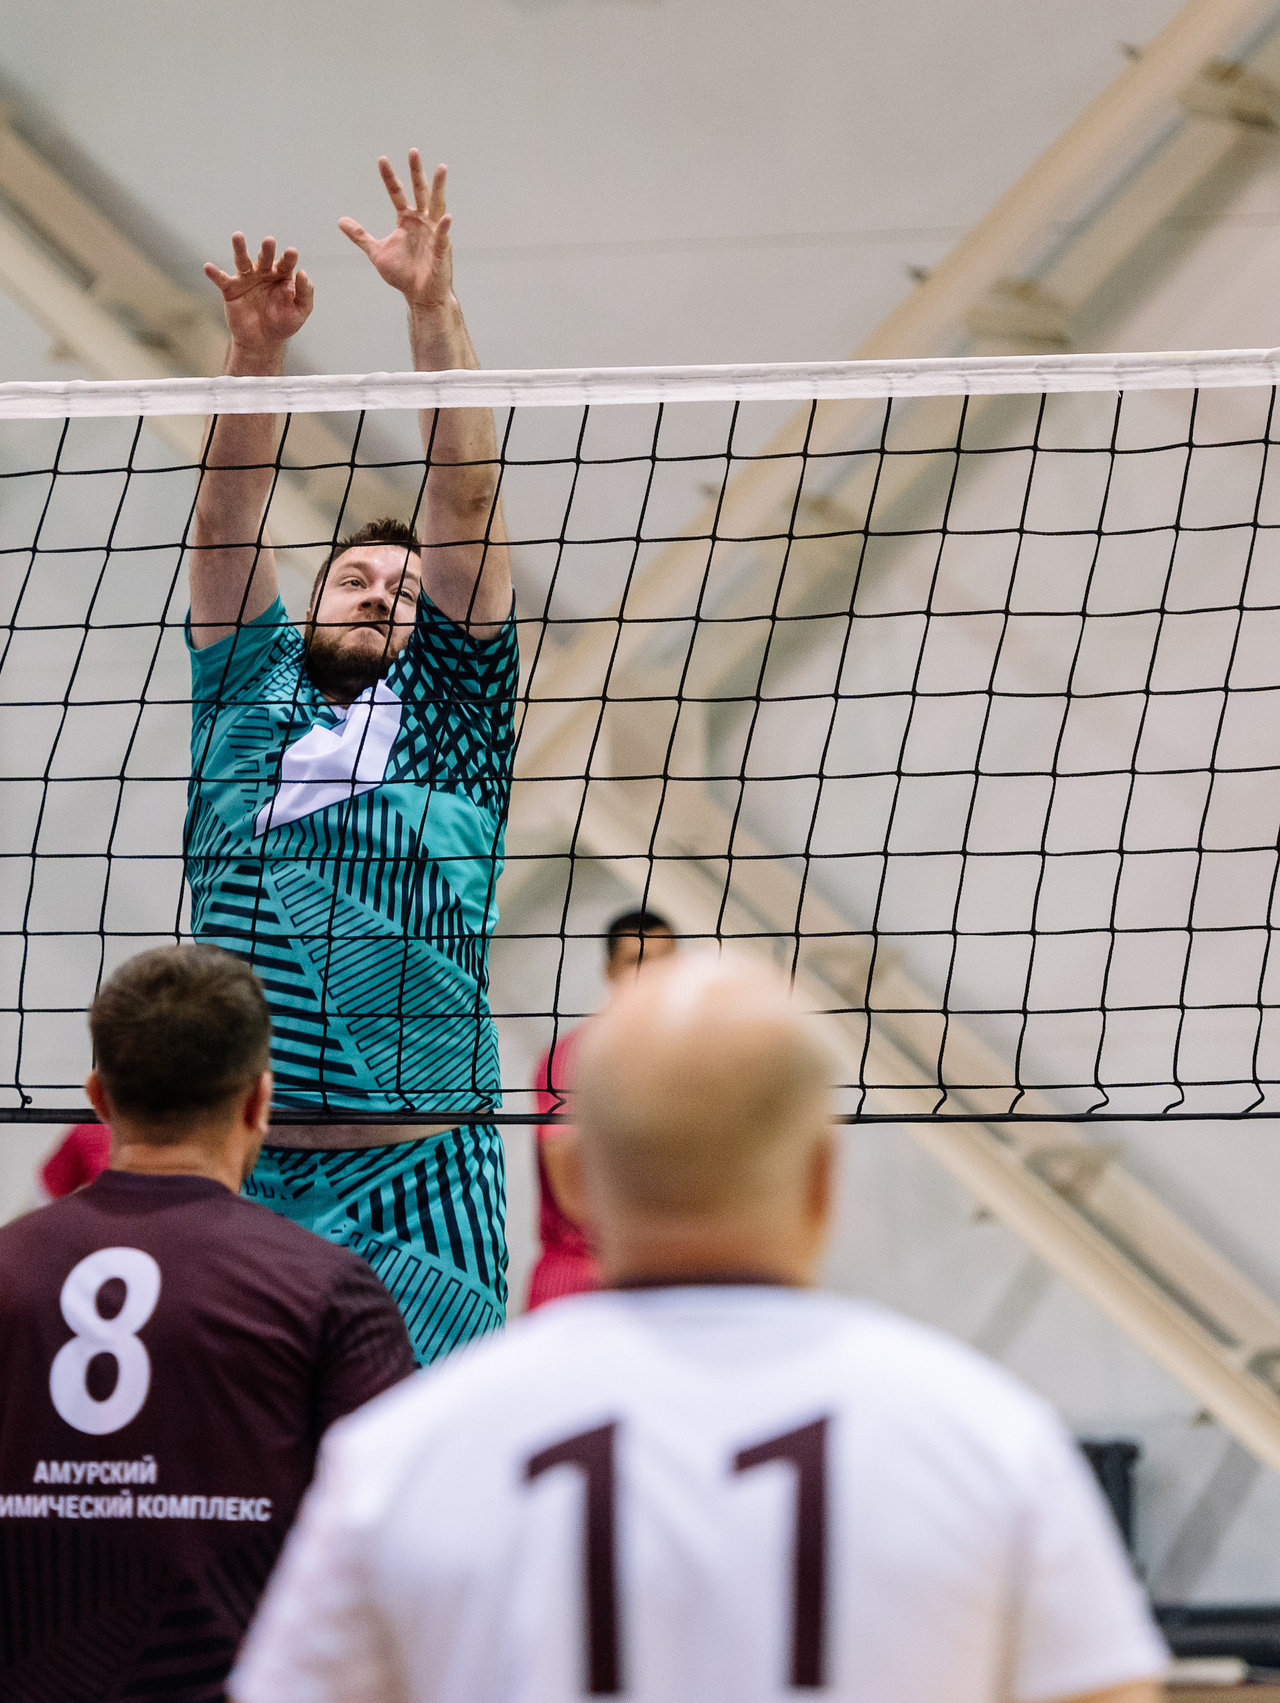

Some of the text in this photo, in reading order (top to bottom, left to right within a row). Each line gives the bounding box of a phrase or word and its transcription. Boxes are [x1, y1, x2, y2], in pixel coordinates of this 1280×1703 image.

[49, 1246, 162, 1436] 8
[33, 1454, 158, 1485] АМУРСКИЙ
[136, 1495, 273, 1522] КОМПЛЕКС
[520, 1413, 832, 1698] 11
